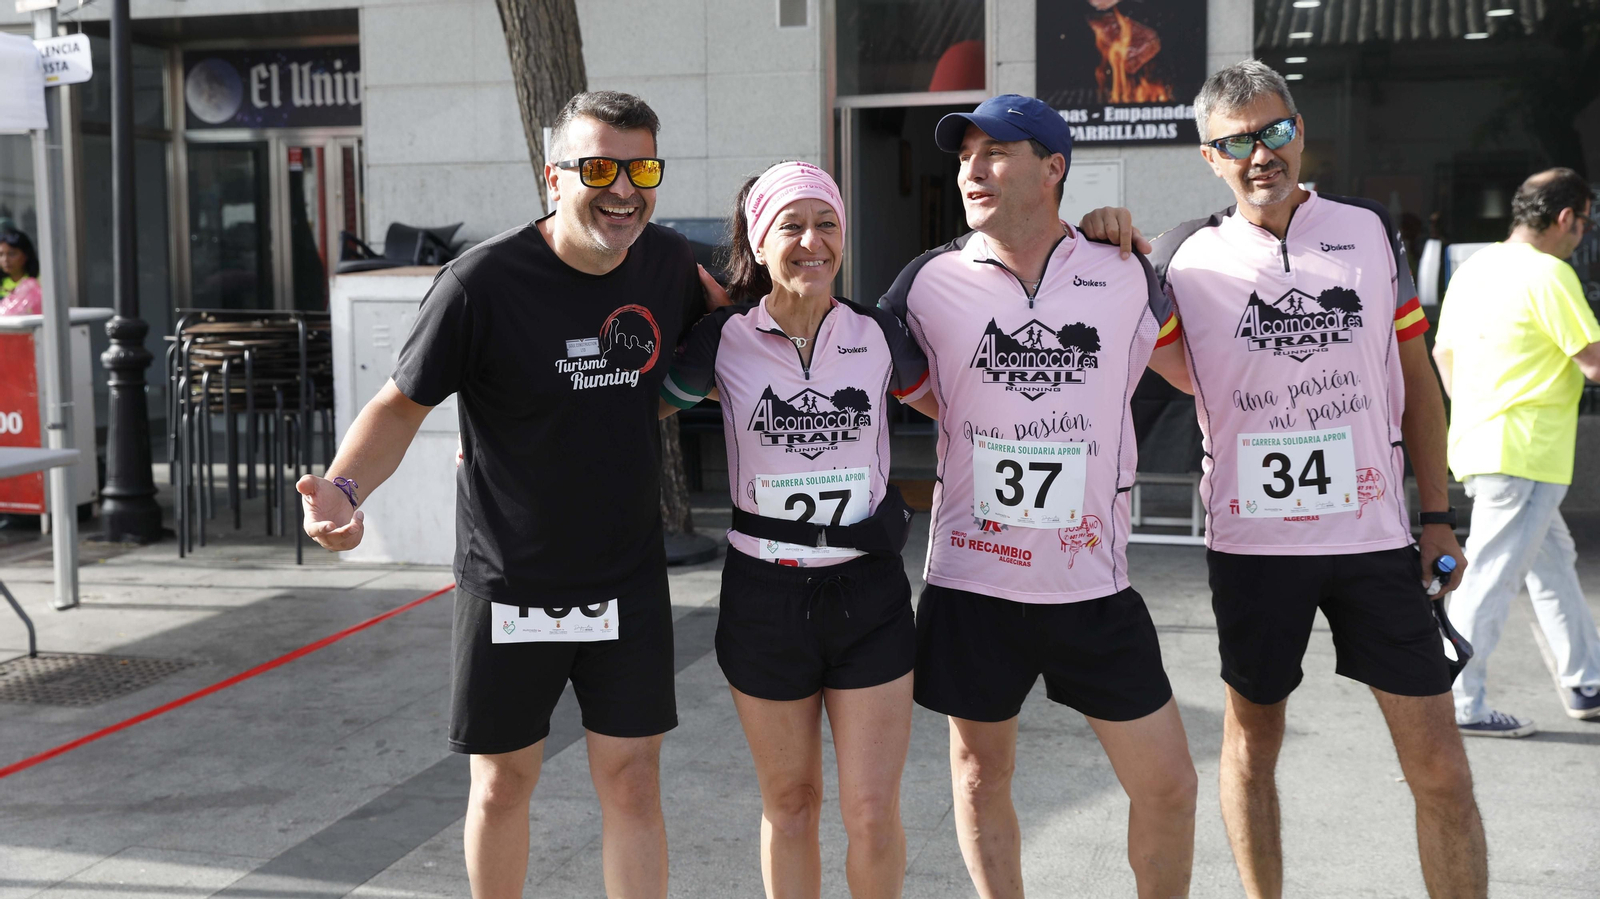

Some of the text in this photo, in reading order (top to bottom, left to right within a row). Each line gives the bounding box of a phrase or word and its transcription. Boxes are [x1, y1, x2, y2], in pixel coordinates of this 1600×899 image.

[250, 63, 282, 109] El
[1252, 332, 1349, 348] TRAIL
[1273, 347, 1329, 356] RUNNING
[555, 358, 608, 374] Turismo
[570, 368, 640, 390] Running
[986, 371, 1082, 382] TRAIL
[1233, 389, 1279, 411] Una
[1269, 393, 1372, 430] mi pasión
[765, 431, 858, 444] TRAIL
[1251, 438, 1281, 447] CARRERA
[1282, 434, 1321, 445] SOLIDARIA
[1323, 431, 1347, 442] APRON
[785, 445, 838, 454] RUNNING
[978, 440, 986, 448] VII
[987, 441, 1016, 454] CARRERA
[1018, 446, 1056, 455] SOLIDARIA
[1057, 447, 1081, 455] APRON
[761, 479, 770, 488] VII
[771, 477, 804, 488] CARRERA
[805, 475, 843, 486] SOLIDARIA
[1261, 449, 1332, 499] 34
[995, 459, 1063, 509] 37
[784, 489, 853, 527] 27
[952, 530, 967, 538] GRUPO
[951, 536, 1032, 561] TU RECAMBIO
[999, 556, 1032, 568] ALGECIRAS
